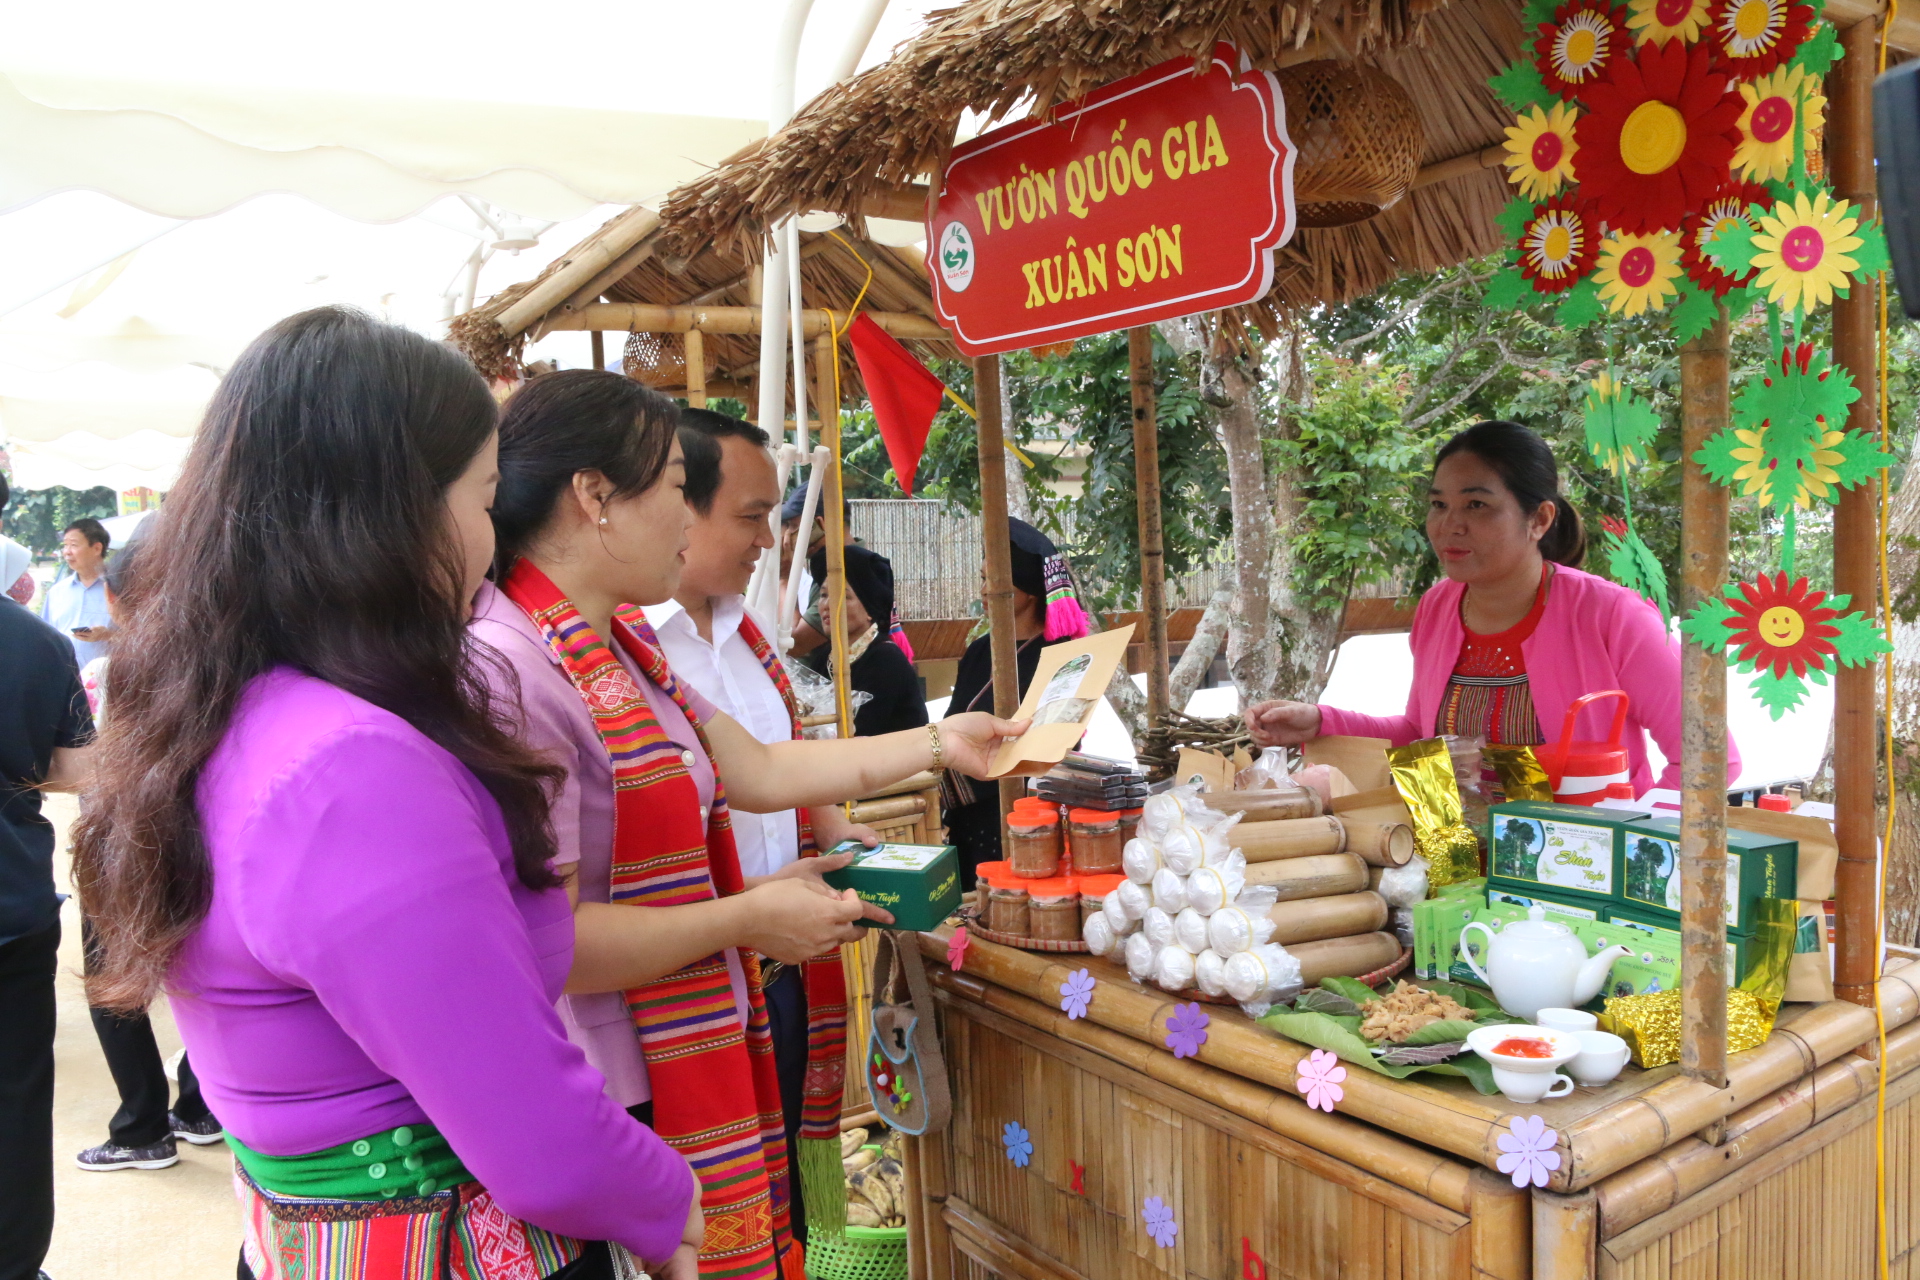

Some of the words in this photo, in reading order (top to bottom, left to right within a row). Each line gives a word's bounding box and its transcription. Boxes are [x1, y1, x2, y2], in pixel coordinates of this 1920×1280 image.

[976, 163, 1057, 235] VƯỜN
[1065, 118, 1153, 219] QUỐC
[1161, 114, 1229, 180] GIA
[1021, 236, 1108, 309] XUÂN
[1116, 224, 1182, 288] SƠN
[1554, 850, 1593, 868] Shan
